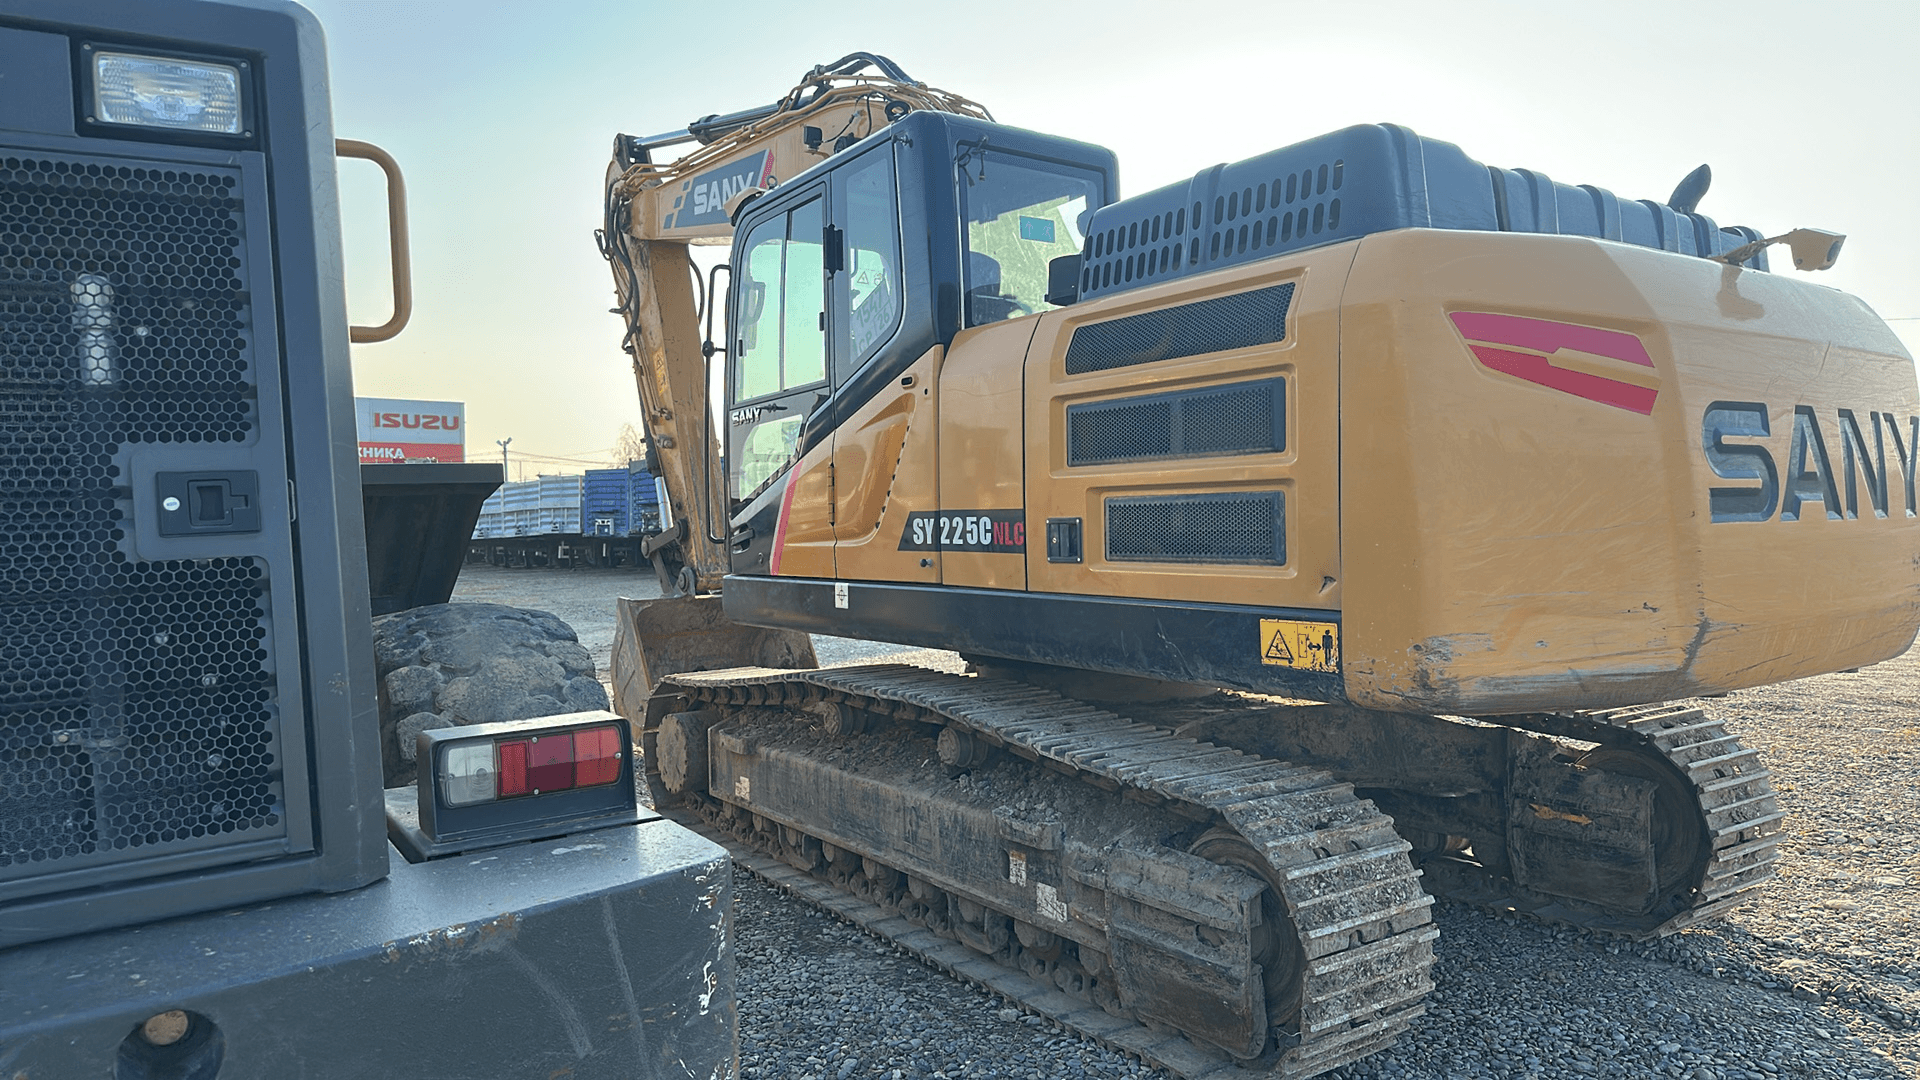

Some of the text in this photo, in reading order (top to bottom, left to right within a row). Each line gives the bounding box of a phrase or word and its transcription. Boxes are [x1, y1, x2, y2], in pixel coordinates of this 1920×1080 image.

[374, 412, 460, 431] ISUZU
[732, 407, 761, 422] SANY
[1702, 400, 1920, 524] SANY
